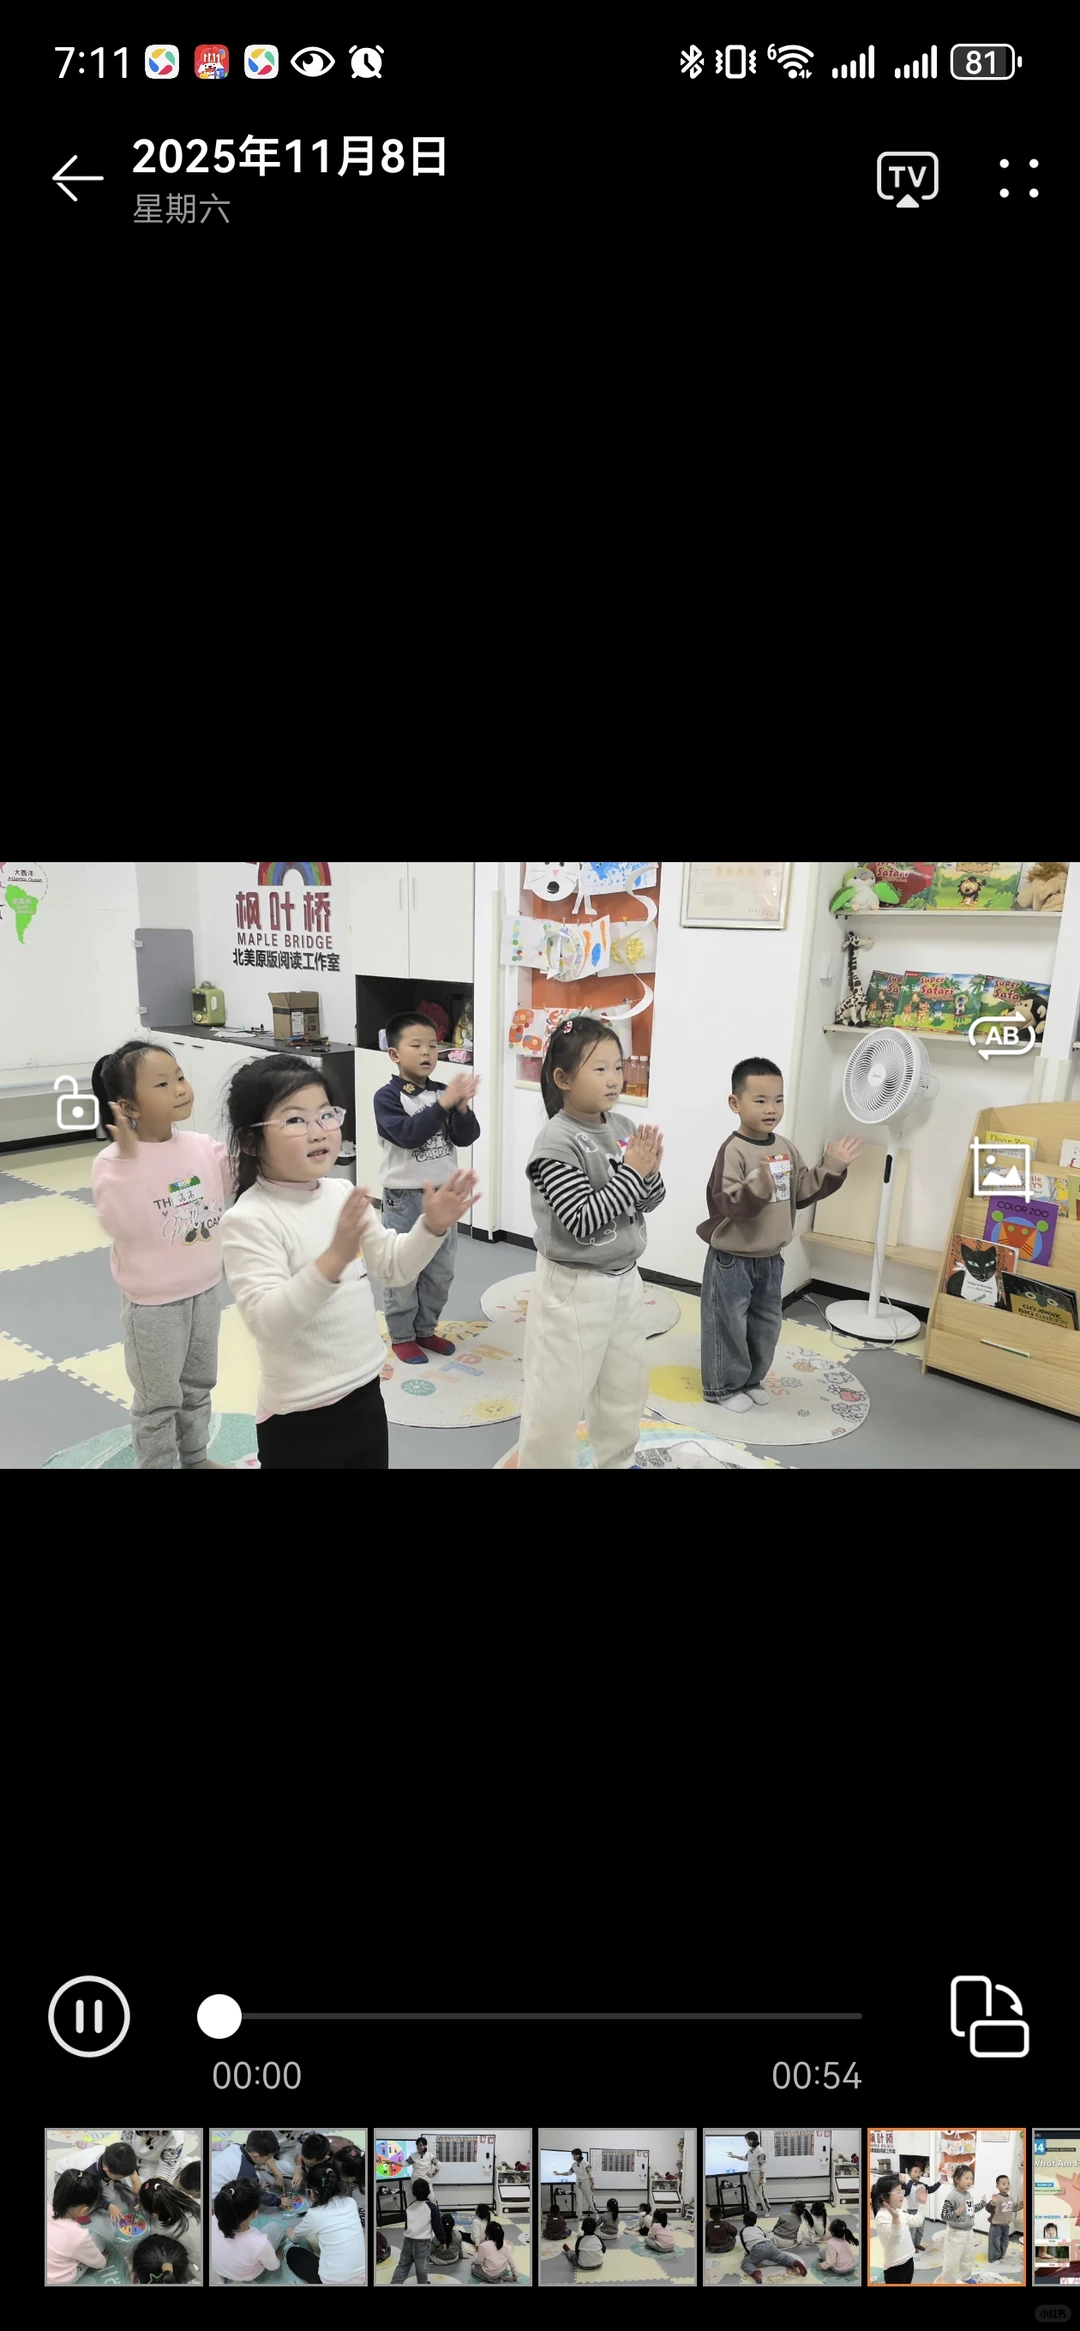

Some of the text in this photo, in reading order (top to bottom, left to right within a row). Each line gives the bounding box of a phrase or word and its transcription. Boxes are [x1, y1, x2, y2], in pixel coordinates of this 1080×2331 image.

[55, 47, 128, 78] 7:11
[966, 51, 995, 74] 81
[133, 133, 445, 177] 2025年11月8日
[888, 166, 927, 188] TV
[133, 193, 231, 225] 星期六
[235, 891, 332, 932] 枫叶桥
[237, 932, 334, 950] MAPLE BRIDGE
[232, 948, 341, 972] 北美原版阅读工作室
[920, 985, 955, 996] Safari
[993, 988, 1020, 1001] Safa
[997, 1200, 1049, 1218] COLOR ZOO
[213, 2060, 302, 2090] 00:00
[773, 2060, 863, 2090] 00:54
